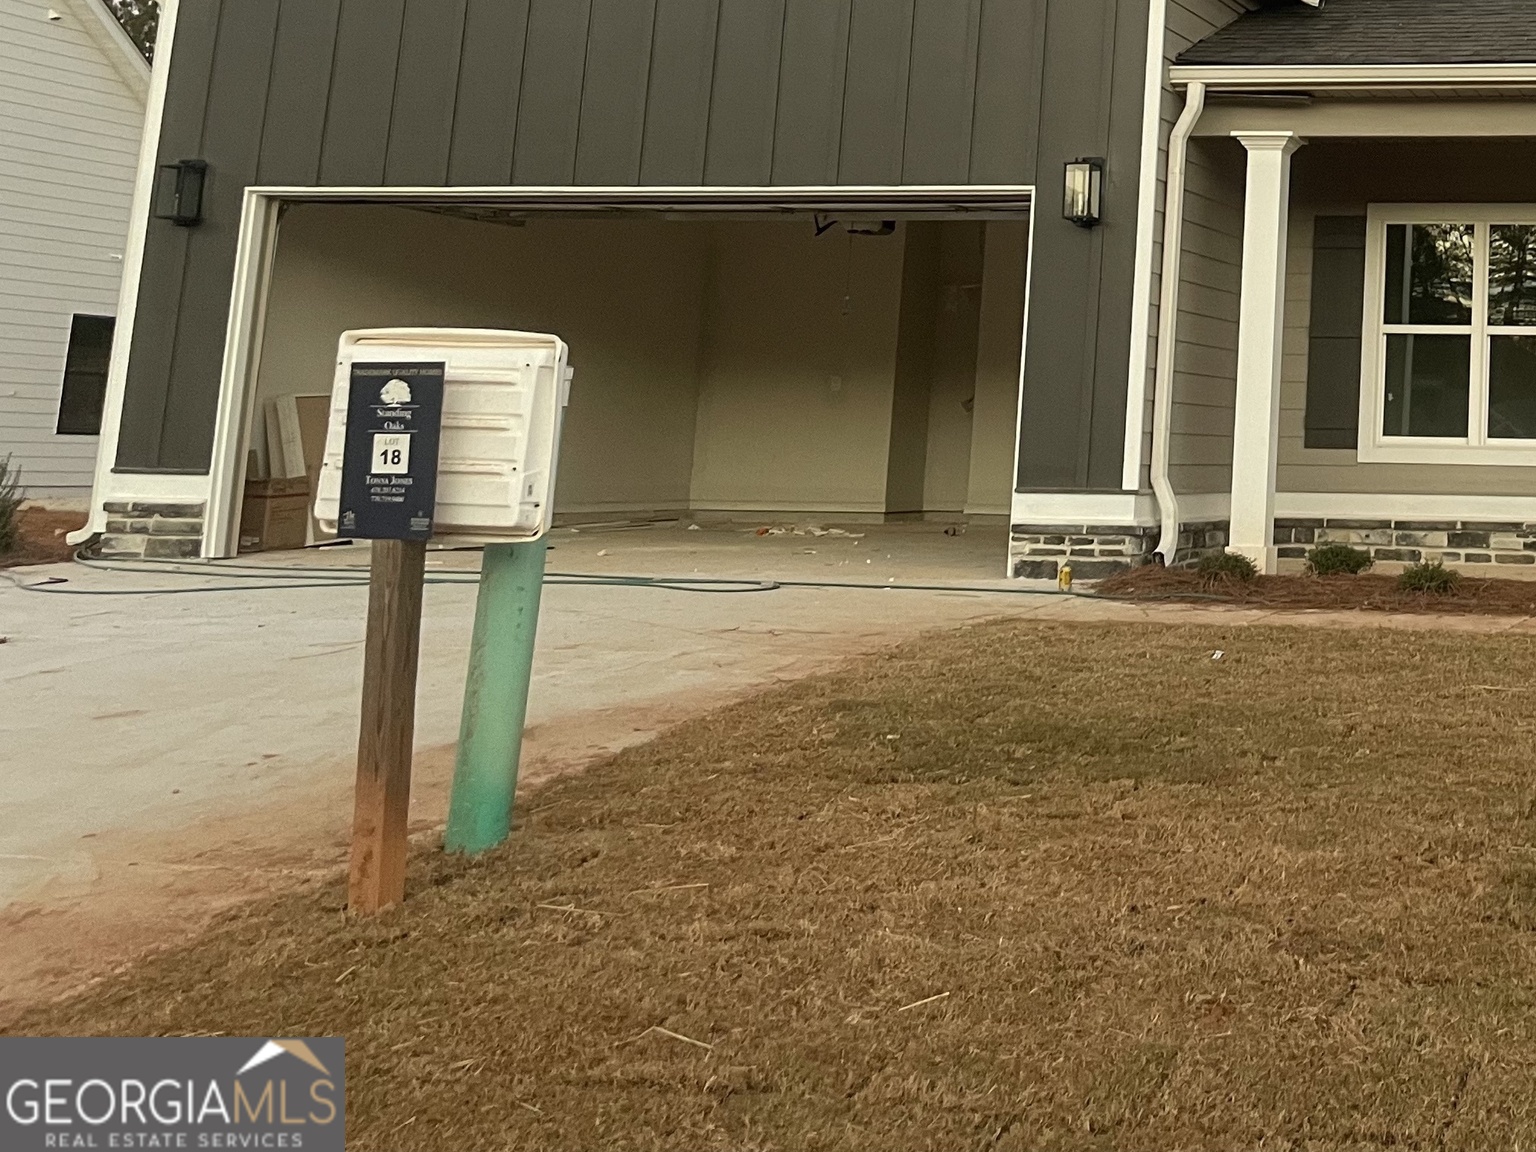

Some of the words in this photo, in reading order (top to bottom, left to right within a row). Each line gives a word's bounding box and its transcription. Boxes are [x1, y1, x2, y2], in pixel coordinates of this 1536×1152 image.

[376, 408, 412, 420] Standing
[384, 421, 404, 430] Oaks
[384, 437, 400, 445] LOT
[380, 449, 401, 465] 18
